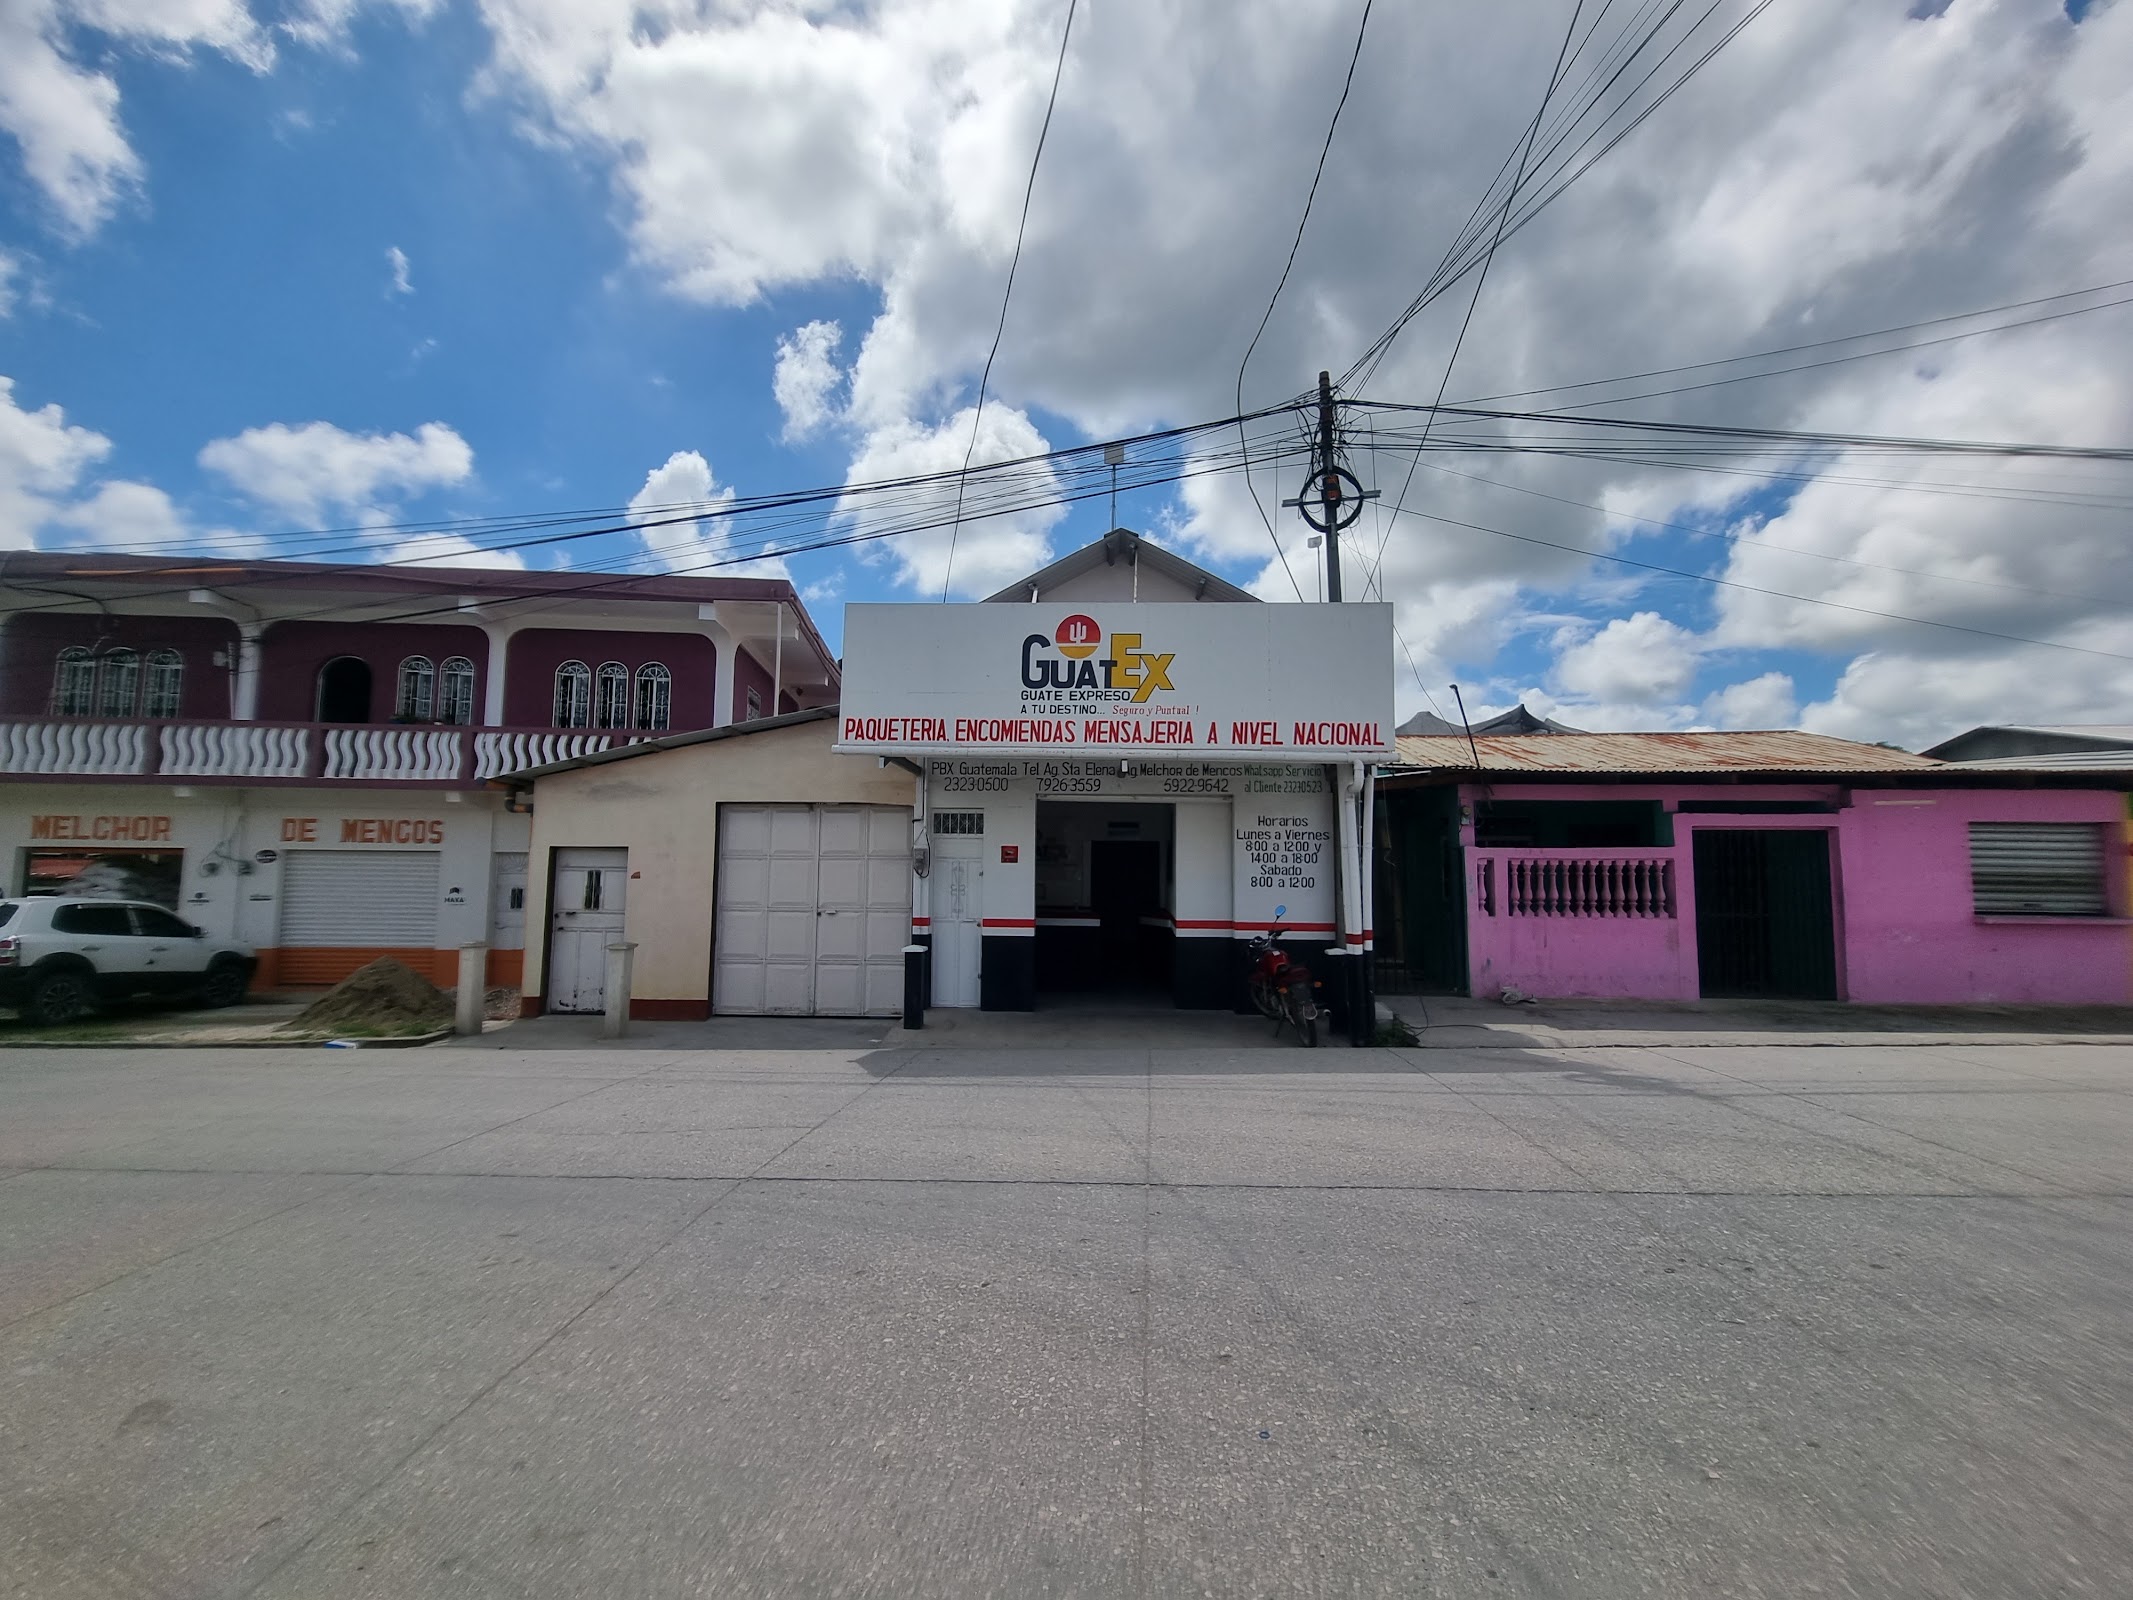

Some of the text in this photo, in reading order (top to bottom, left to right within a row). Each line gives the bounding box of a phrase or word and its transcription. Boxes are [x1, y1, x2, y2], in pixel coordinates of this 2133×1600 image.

[1021, 690, 1131, 701] GUATE EXPRESO
[1020, 704, 1027, 715] A
[1032, 704, 1046, 715] TU
[1112, 704, 1145, 717] Seguro
[1147, 708, 1153, 717] y
[1155, 704, 1190, 715] Puntual
[955, 719, 1076, 743] ENCOMIENDAS
[1084, 720, 1194, 744] MENSAJERIA
[1207, 721, 1219, 744] A
[1231, 722, 1284, 745] NIVEL
[1293, 723, 1385, 746] NACIONAL
[932, 762, 954, 776] PBX
[959, 762, 1017, 776] Guatemala
[1022, 762, 1039, 776] Tel
[1062, 762, 1080, 776] Sta
[1085, 763, 1116, 776] Elena
[1186, 763, 1199, 776] de
[1202, 764, 1242, 776] Mencos
[1285, 765, 1322, 776] Servicio
[1164, 779, 1228, 792] 5922-9642
[1253, 780, 1281, 793] Cliente
[1257, 816, 1309, 827] Horarios
[31, 815, 444, 844] MELCHOR DE MENCOS
[1236, 829, 1329, 841] Lunes a Viernes
[1272, 843, 1279, 851] a
[1314, 843, 1322, 853] y
[1280, 855, 1288, 864] a
[1260, 865, 1302, 876] Sabado
[1278, 879, 1285, 888] a
